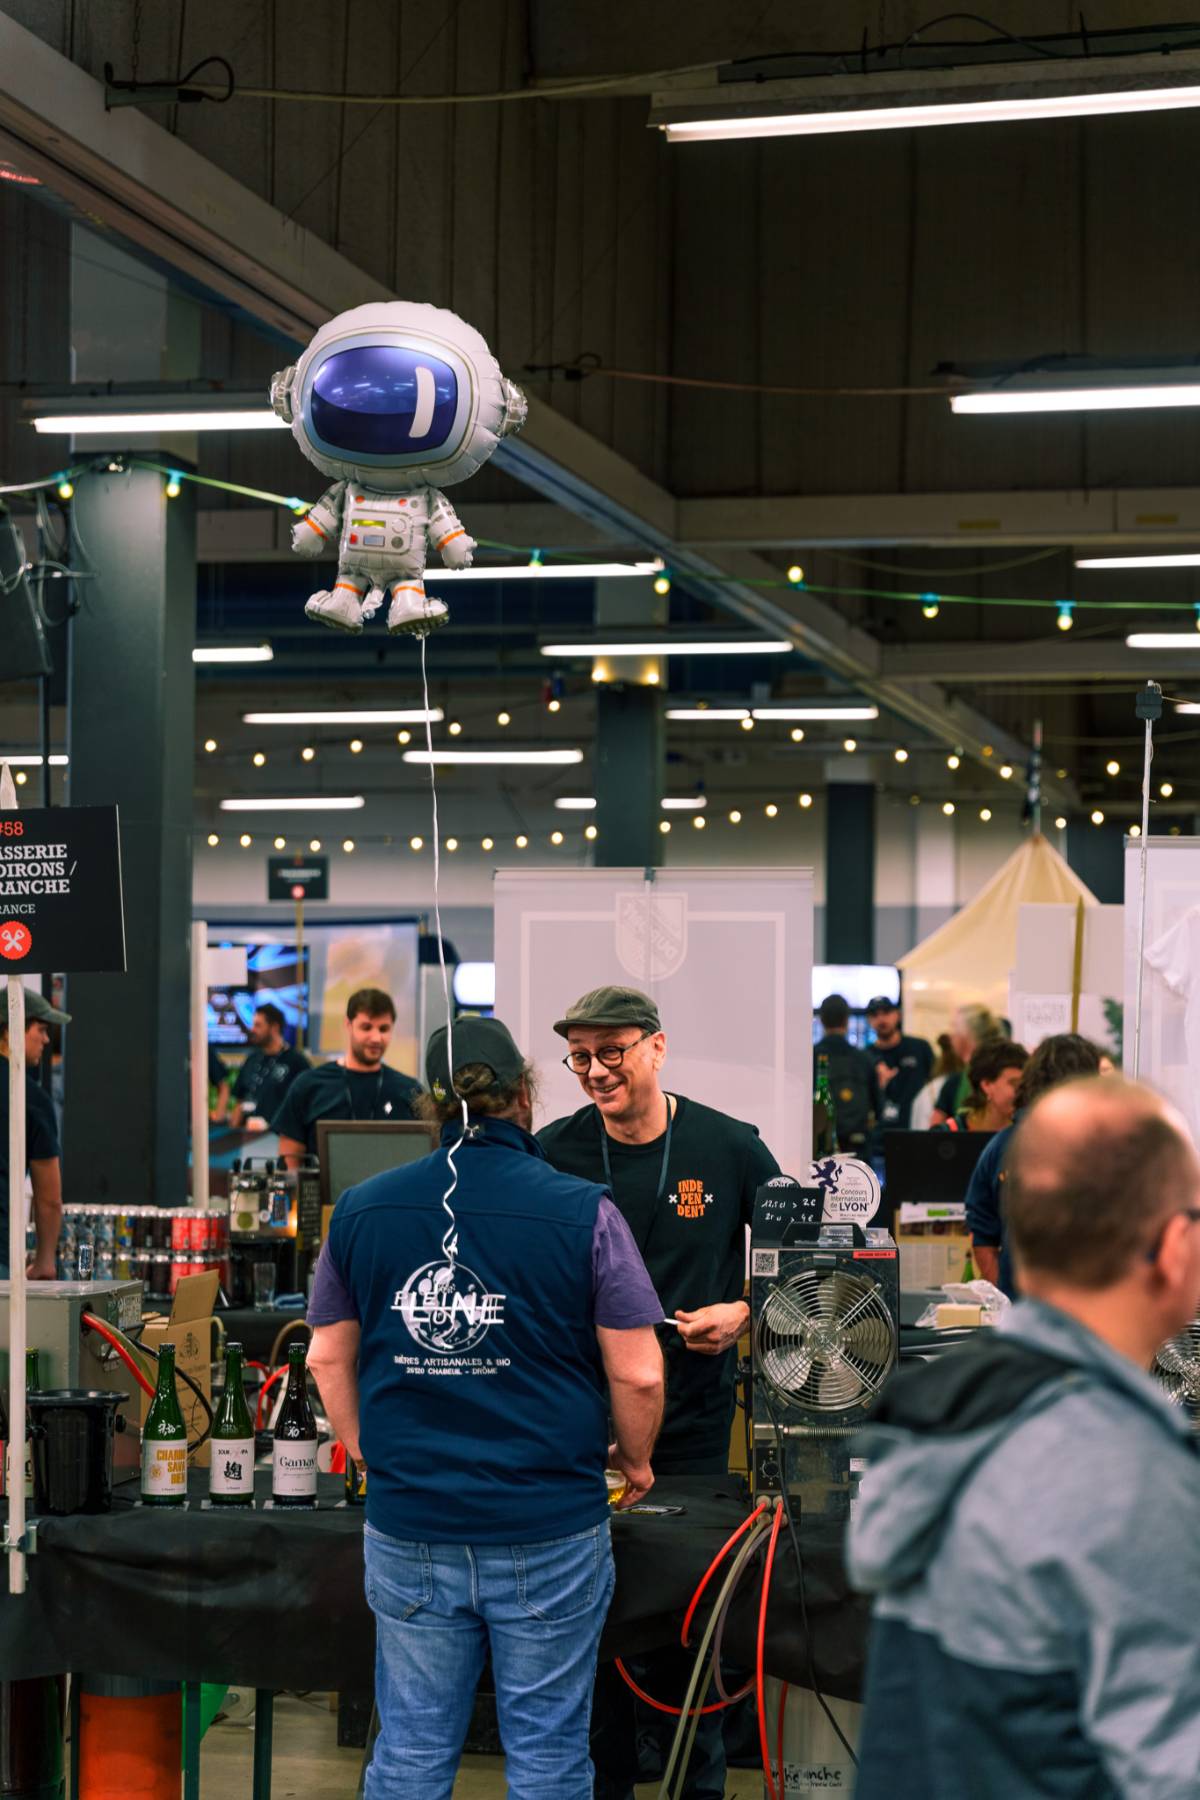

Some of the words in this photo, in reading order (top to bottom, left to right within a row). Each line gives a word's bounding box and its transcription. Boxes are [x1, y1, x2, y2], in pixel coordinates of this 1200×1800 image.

[841, 1188, 867, 1196] Concours
[840, 1202, 867, 1212] LYON
[423, 1358, 483, 1366] ARTISANALES
